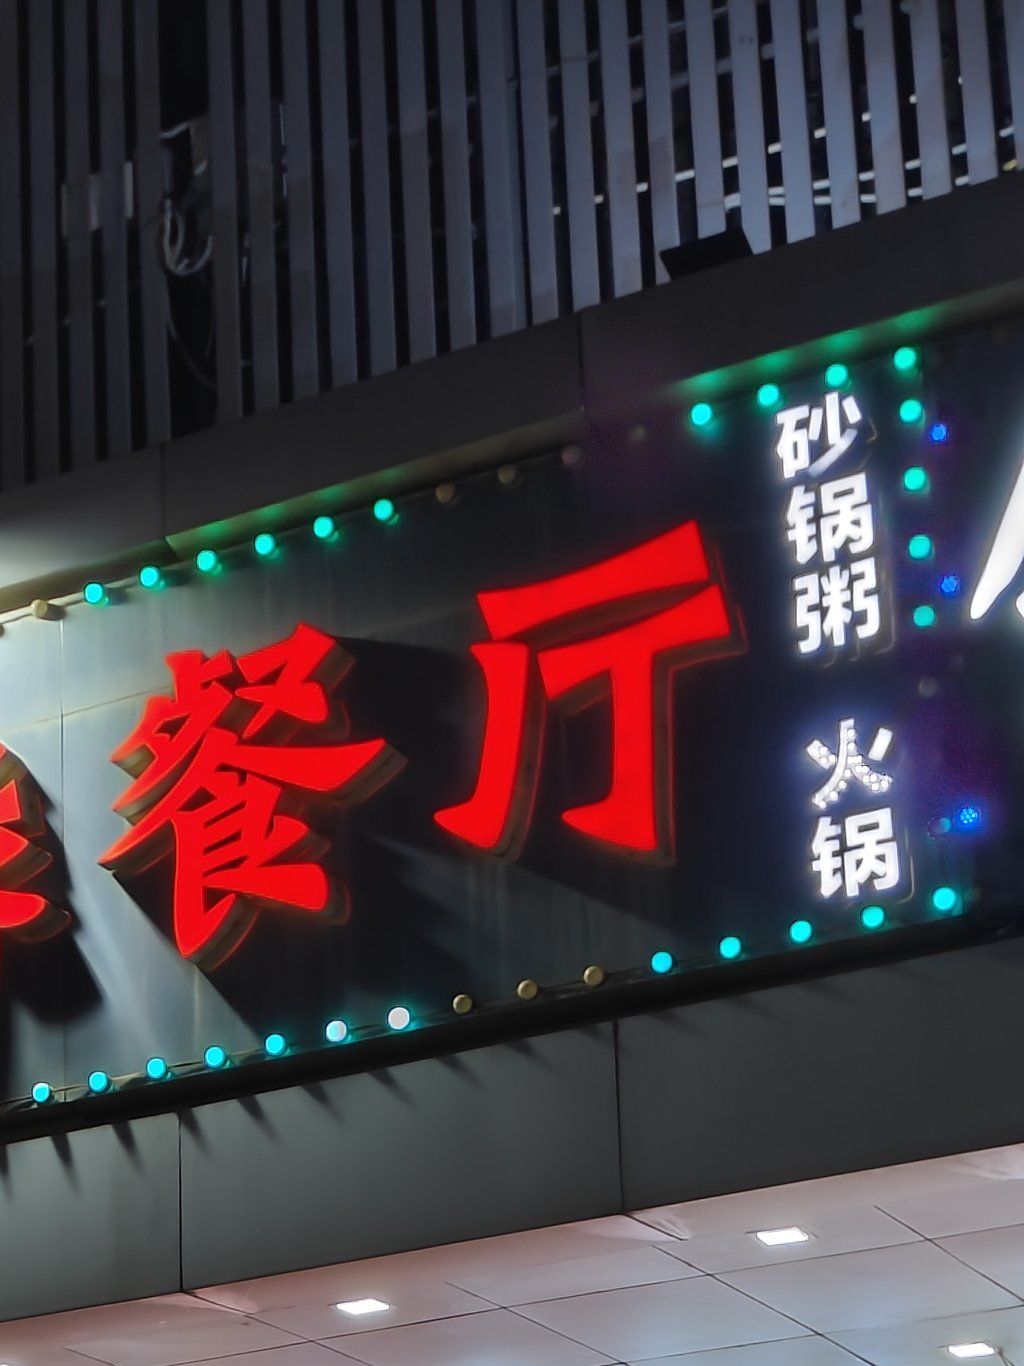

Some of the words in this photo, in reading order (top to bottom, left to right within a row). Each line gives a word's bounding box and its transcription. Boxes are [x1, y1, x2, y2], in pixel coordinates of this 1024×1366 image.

[775, 391, 879, 655] 砂锅粥
[805, 717, 901, 900] 火锅
